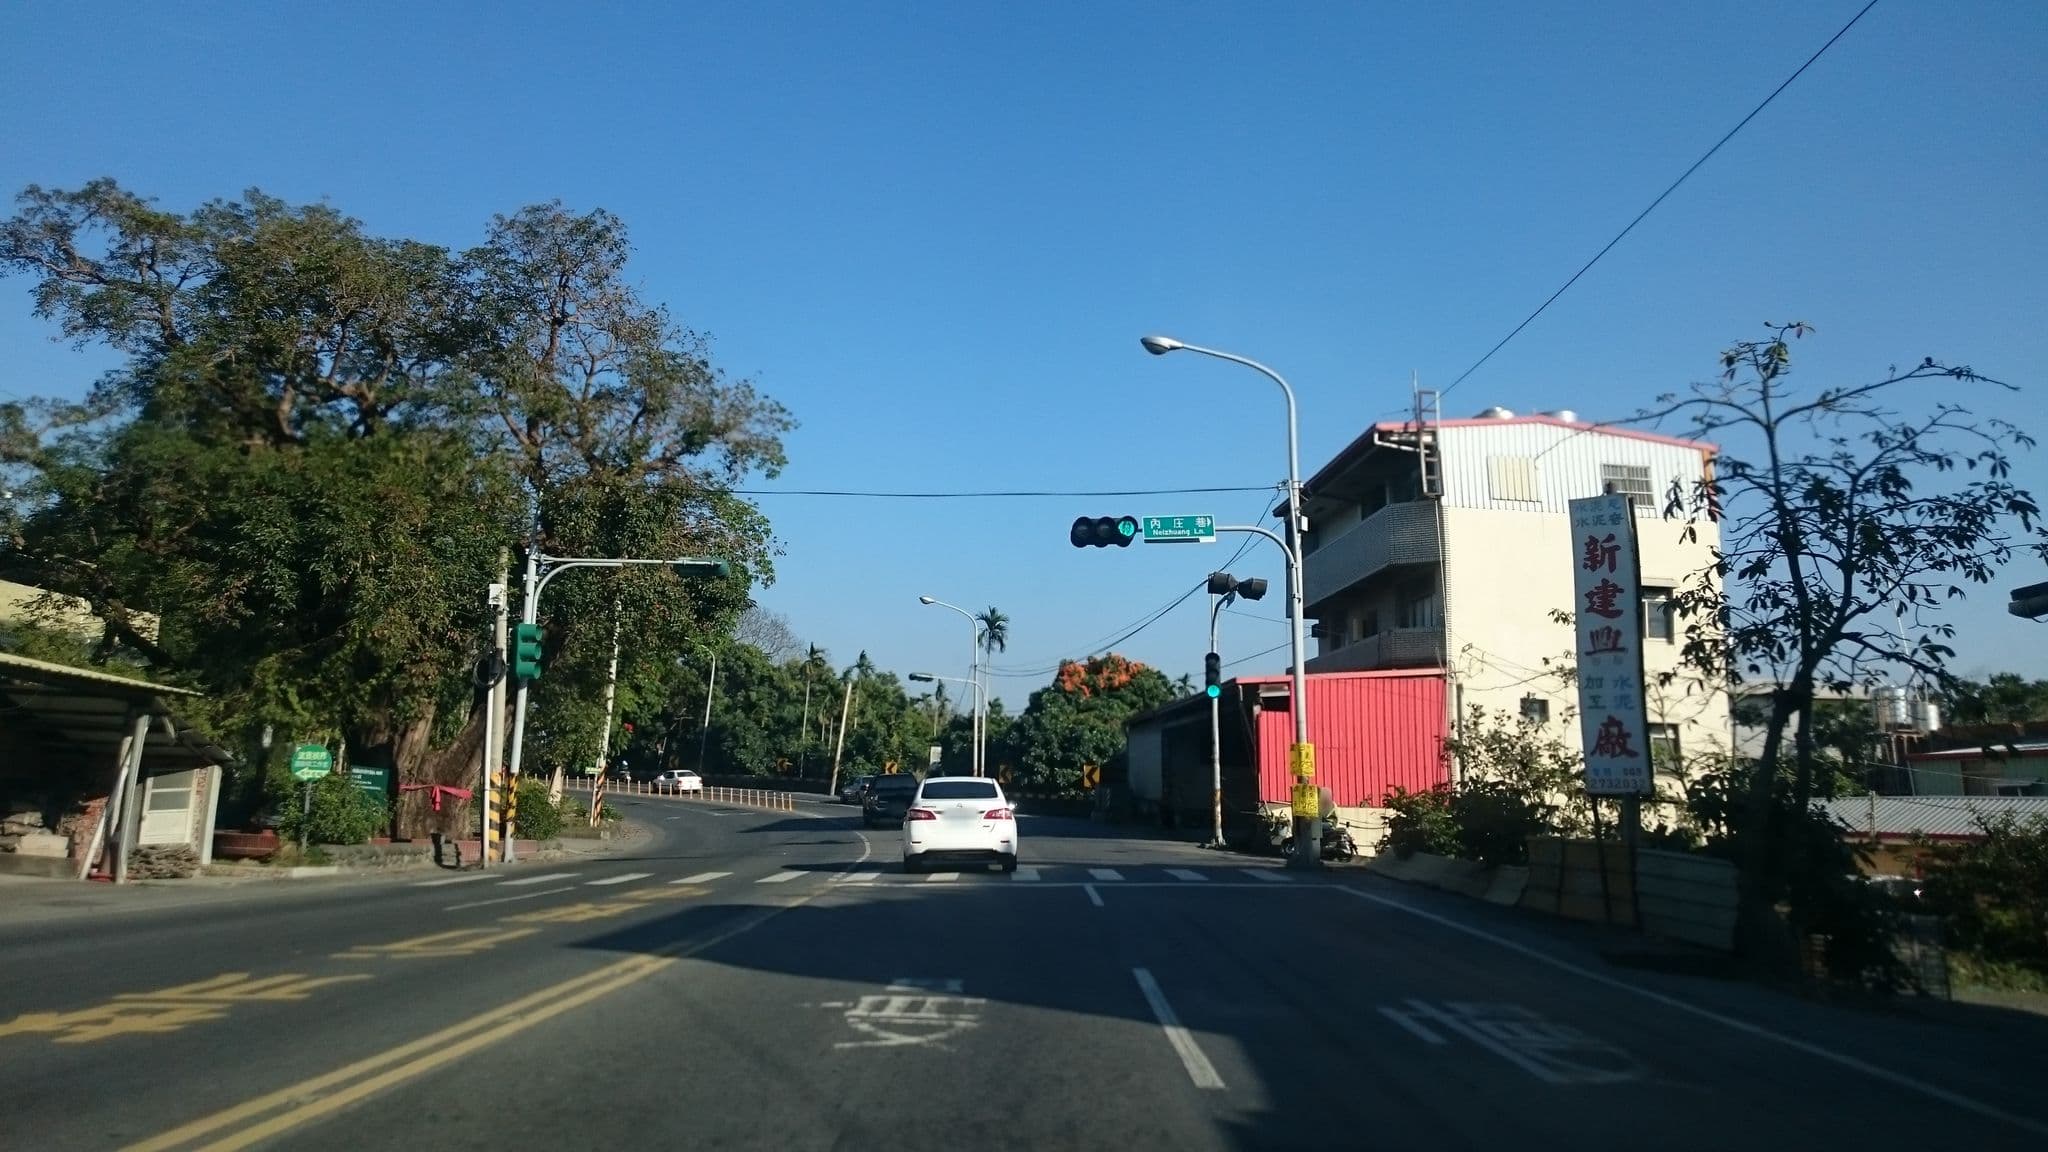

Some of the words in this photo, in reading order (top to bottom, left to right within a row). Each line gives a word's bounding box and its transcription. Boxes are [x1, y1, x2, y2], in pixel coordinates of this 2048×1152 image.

[1150, 517, 1206, 529] 內庄巷
[1152, 528, 1190, 536] Neizhuang
